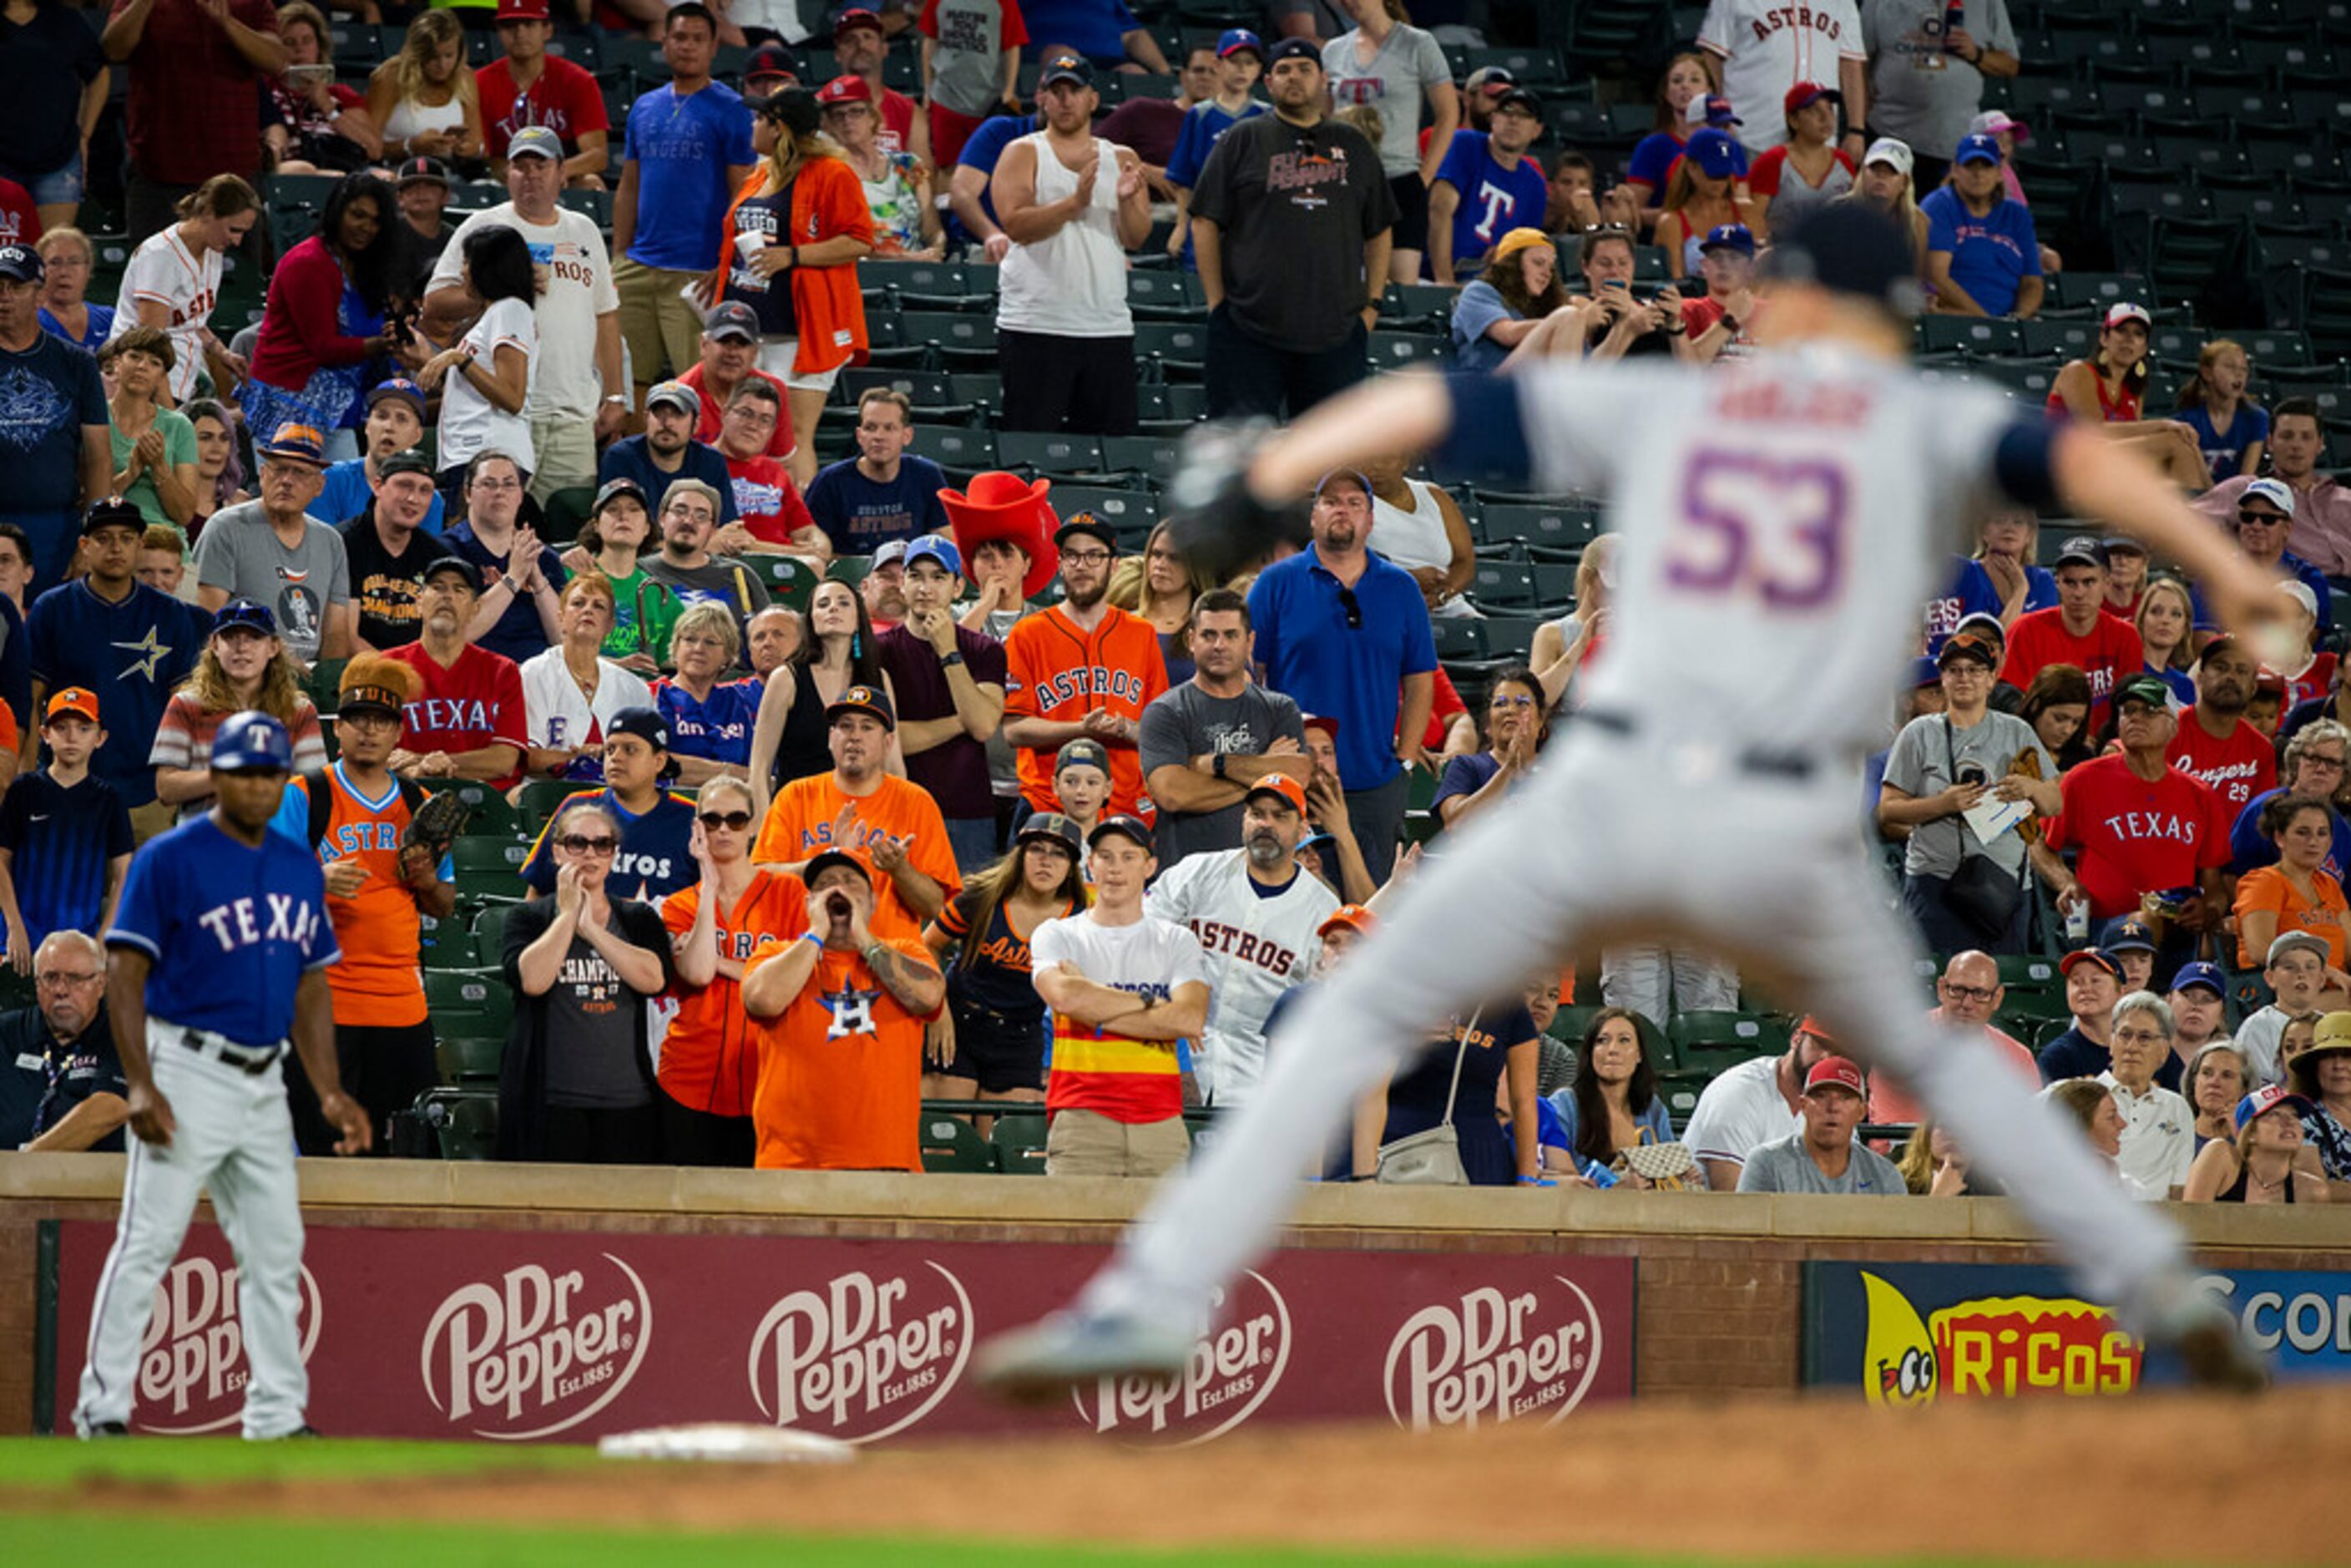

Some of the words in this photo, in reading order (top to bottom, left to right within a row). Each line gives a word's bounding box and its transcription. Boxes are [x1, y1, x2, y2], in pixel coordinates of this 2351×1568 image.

[1752, 7, 1842, 41] ASTROS
[1339, 78, 1384, 105] T
[497, 108, 567, 139] TAS
[1474, 180, 1514, 244] T
[1720, 223, 1737, 240] T
[555, 261, 594, 287] ROS
[849, 512, 913, 534] ASTROS
[857, 503, 904, 516] HOUSTON
[1665, 447, 1850, 612] 53
[355, 686, 397, 710] YULI
[1035, 665, 1144, 711] ASTROS
[248, 725, 272, 751] T
[2228, 782, 2250, 802] 29
[319, 822, 398, 865] ASTR
[2104, 812, 2197, 846] TEXAS
[611, 844, 673, 878] tros
[1190, 918, 1296, 977] ASTROS
[2197, 962, 2214, 975] T
[827, 993, 877, 1037] H
[171, 1257, 240, 1341] Dr
[503, 1264, 584, 1348] Dr
[829, 1272, 907, 1354] Dr
[1460, 1287, 1537, 1368] Dr
[422, 1282, 635, 1422] Pepper
[749, 1291, 956, 1427] Pepper
[1384, 1306, 1585, 1434] Pepper
